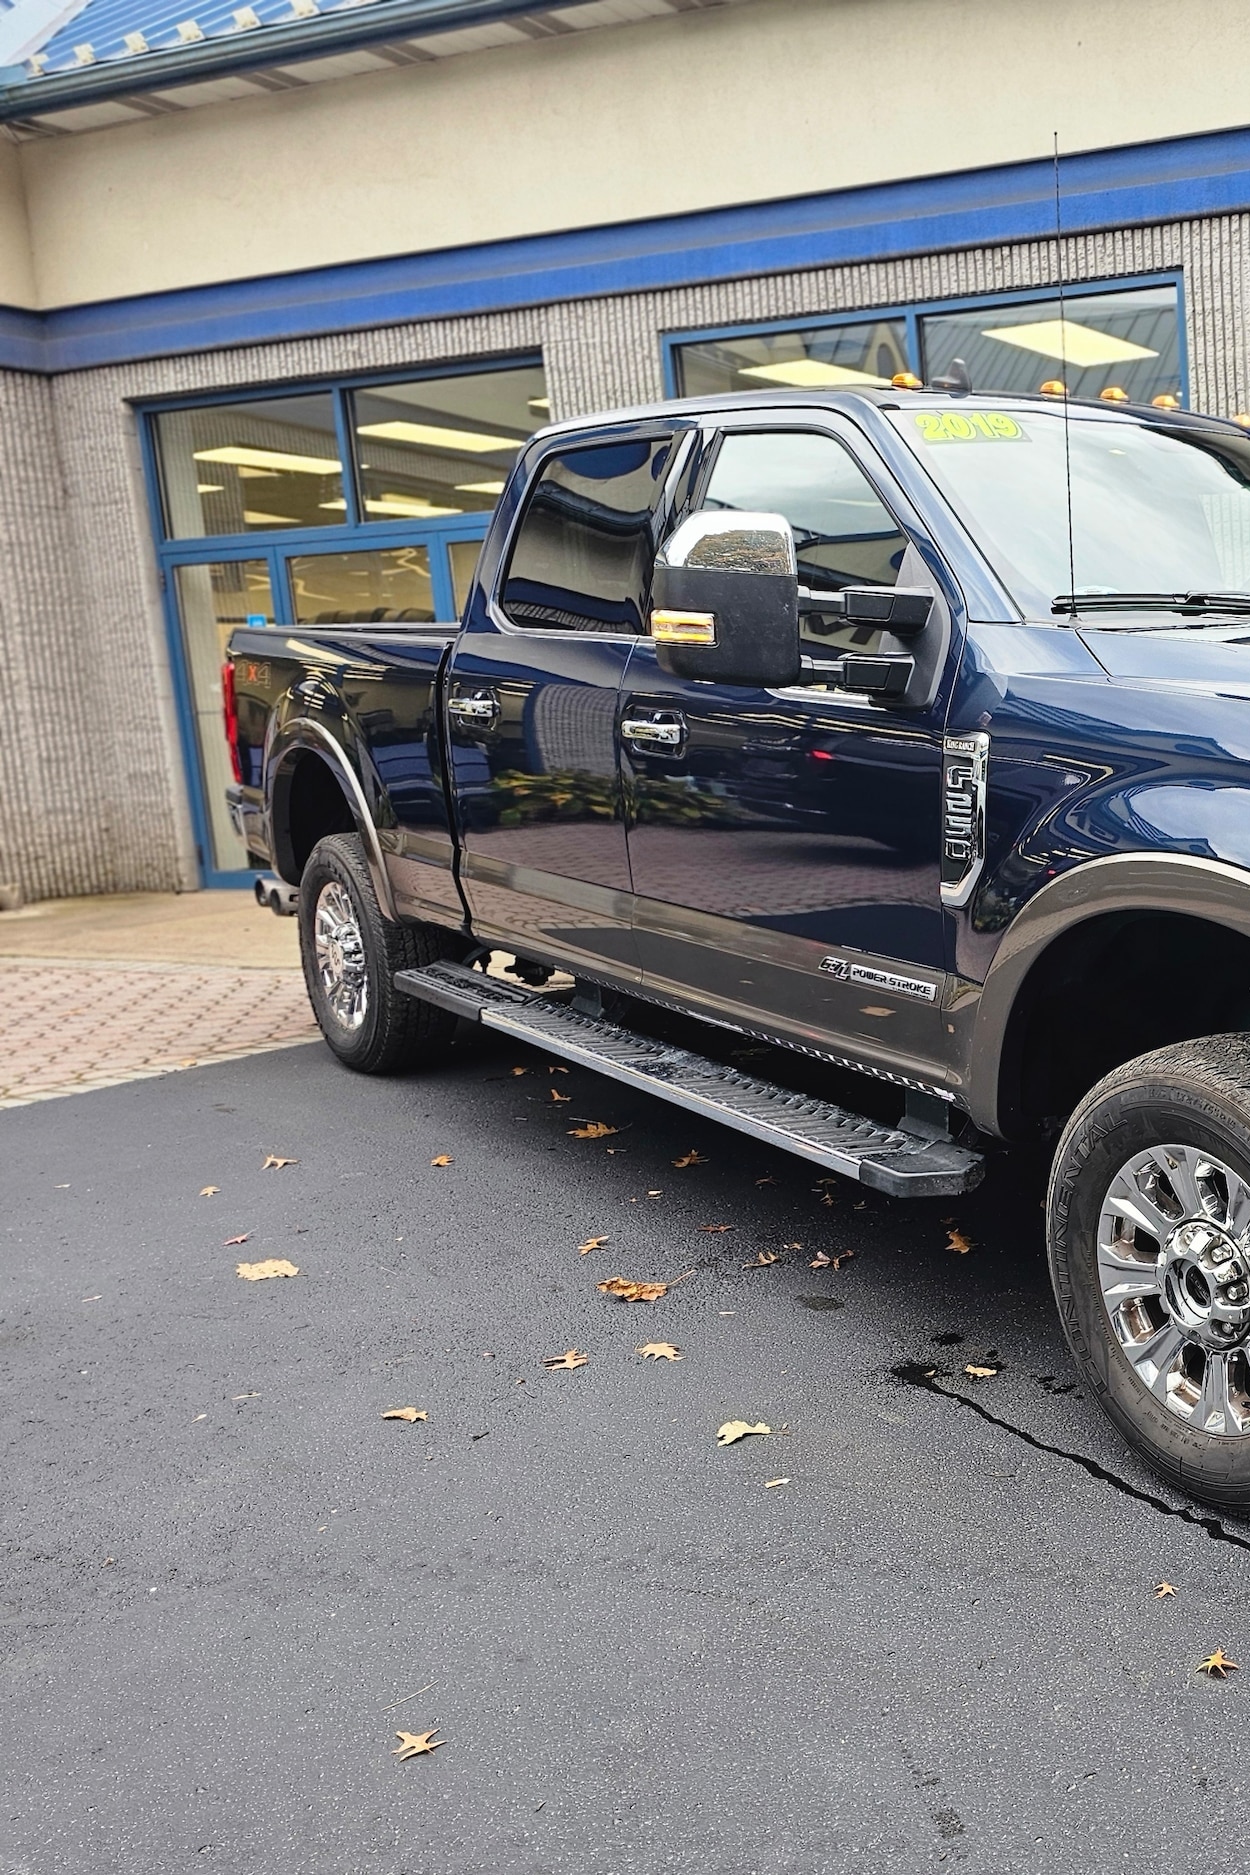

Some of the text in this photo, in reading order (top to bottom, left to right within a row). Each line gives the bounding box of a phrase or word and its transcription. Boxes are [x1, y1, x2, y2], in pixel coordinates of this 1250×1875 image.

[914, 412, 1023, 441] 2019
[851, 967, 887, 984] POWER
[888, 977, 932, 996] STROKE
[1055, 1111, 1128, 1394] CONTINENTAL
